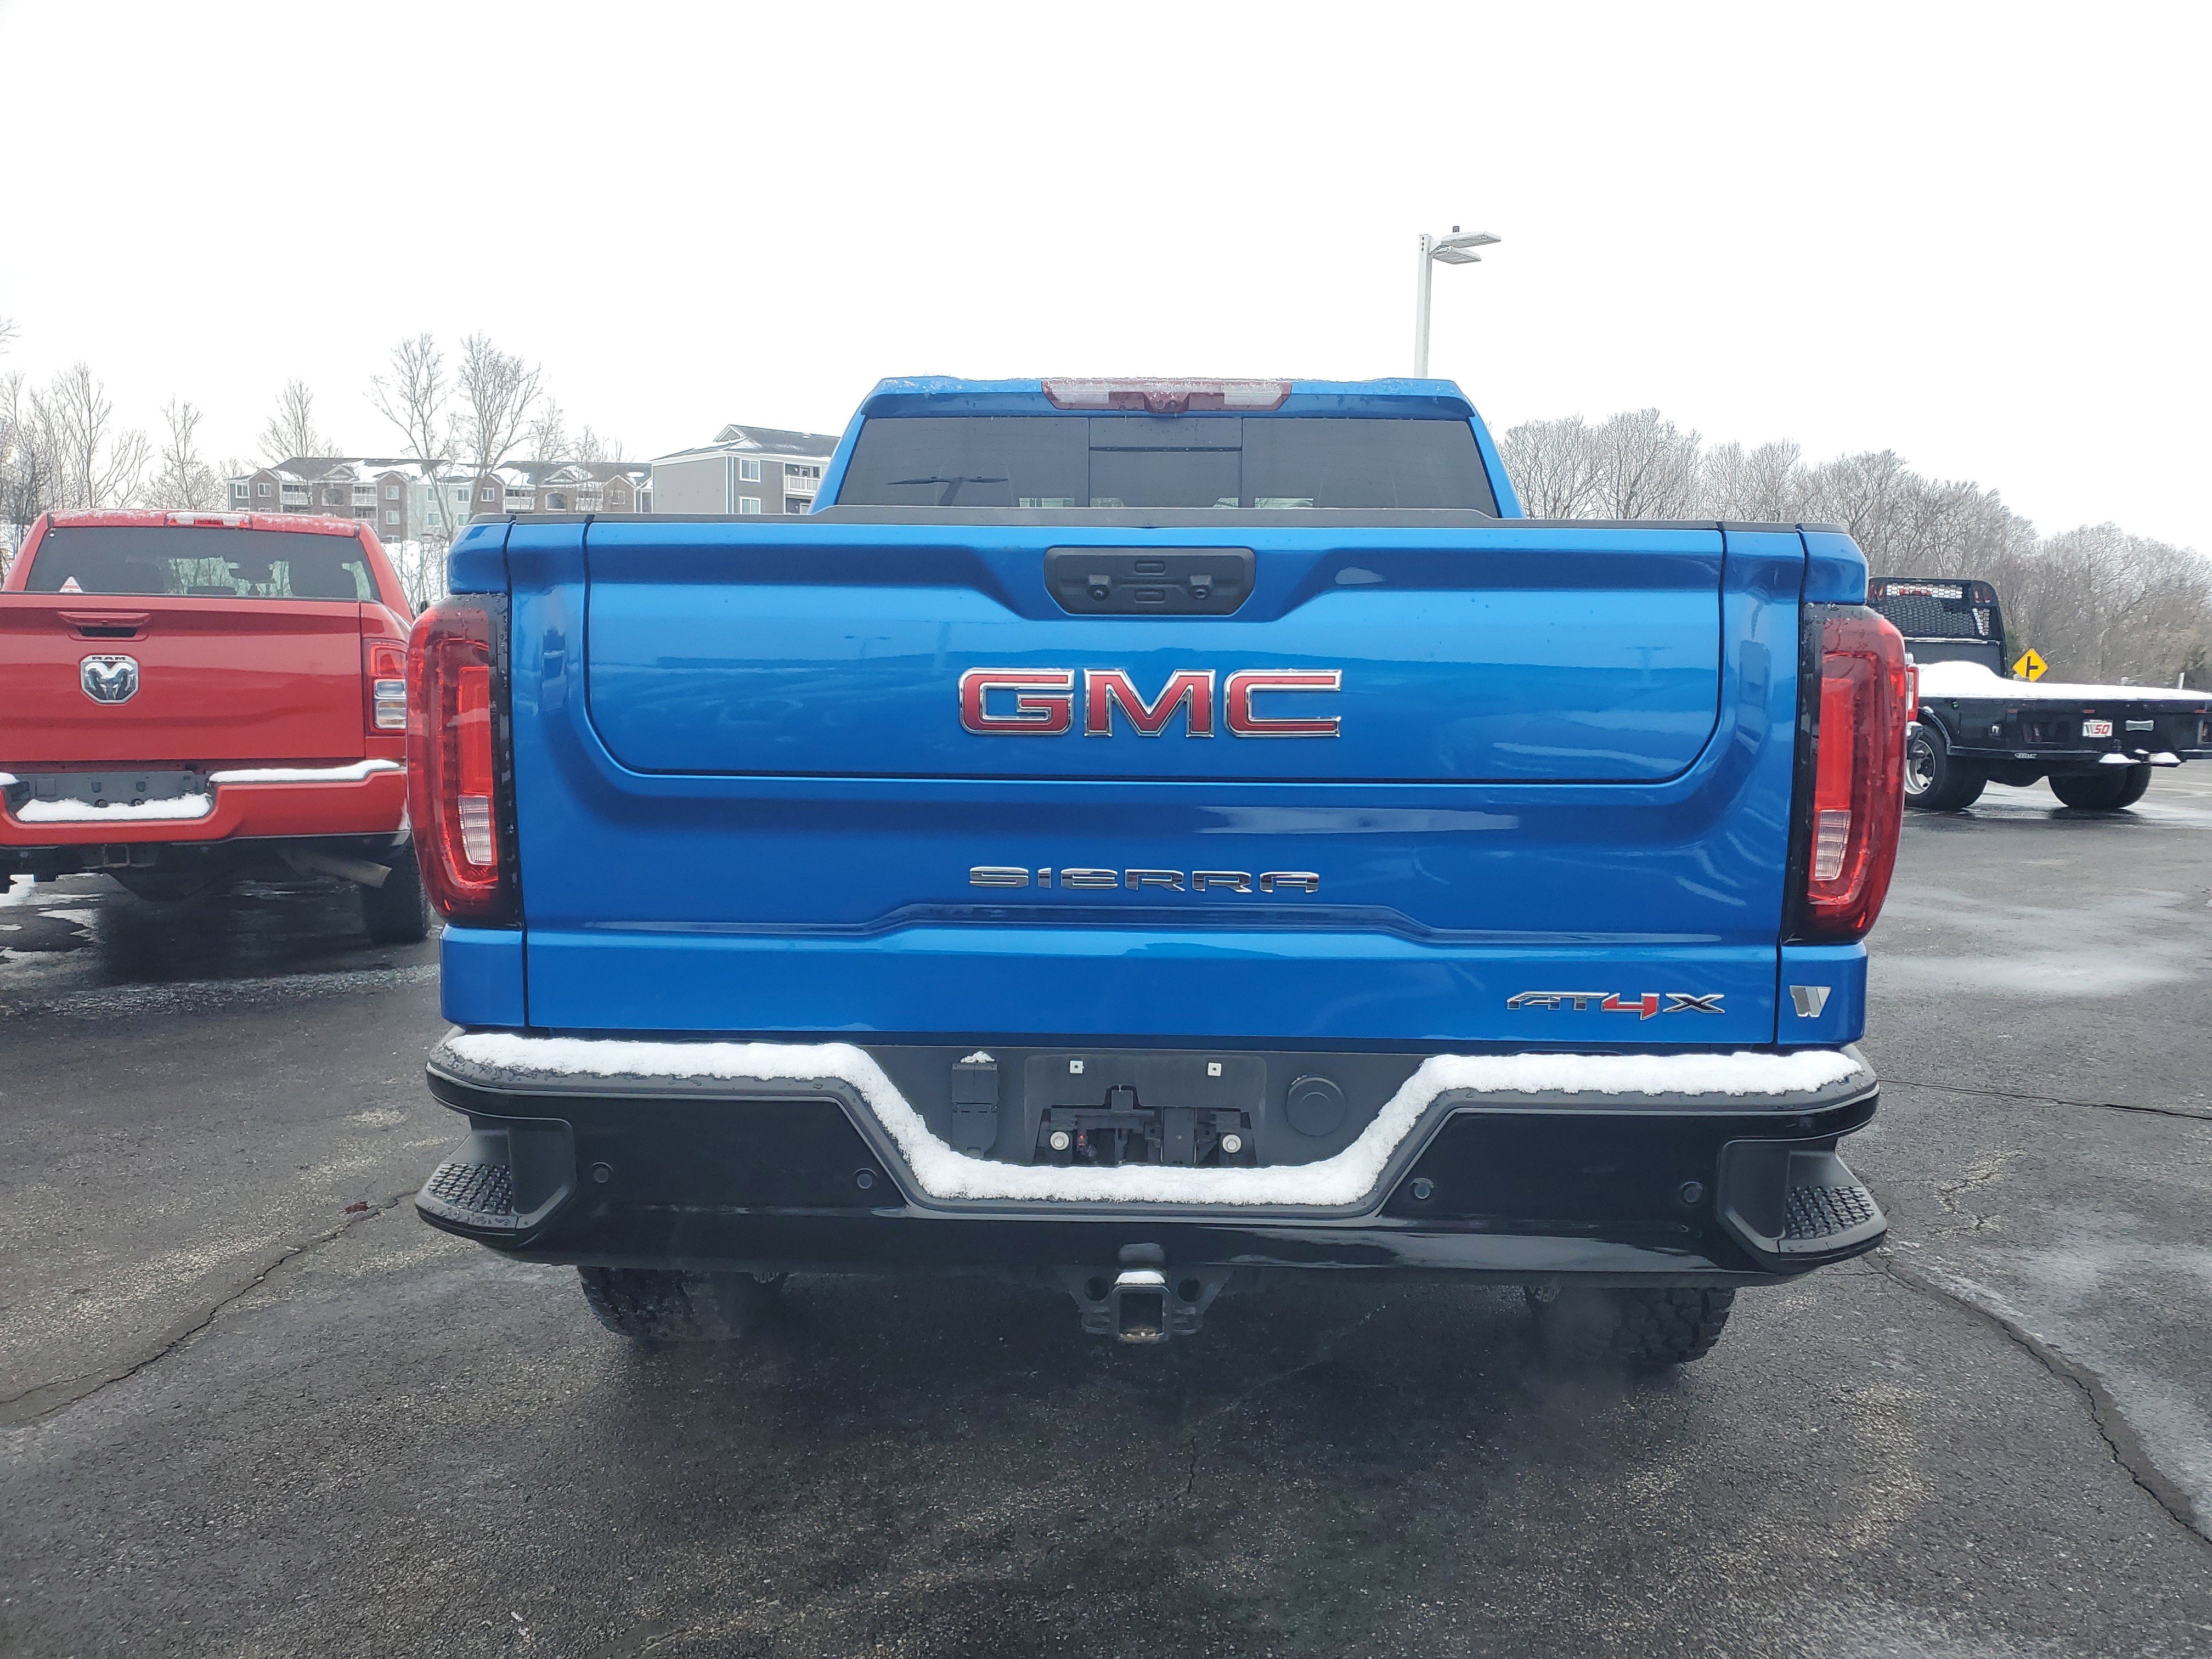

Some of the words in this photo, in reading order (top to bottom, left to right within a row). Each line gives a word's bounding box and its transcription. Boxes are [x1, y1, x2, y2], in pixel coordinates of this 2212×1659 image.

[958, 668, 1342, 738] GMC
[969, 866, 1319, 894] SIERRA
[1506, 991, 1725, 1020] AT4X
